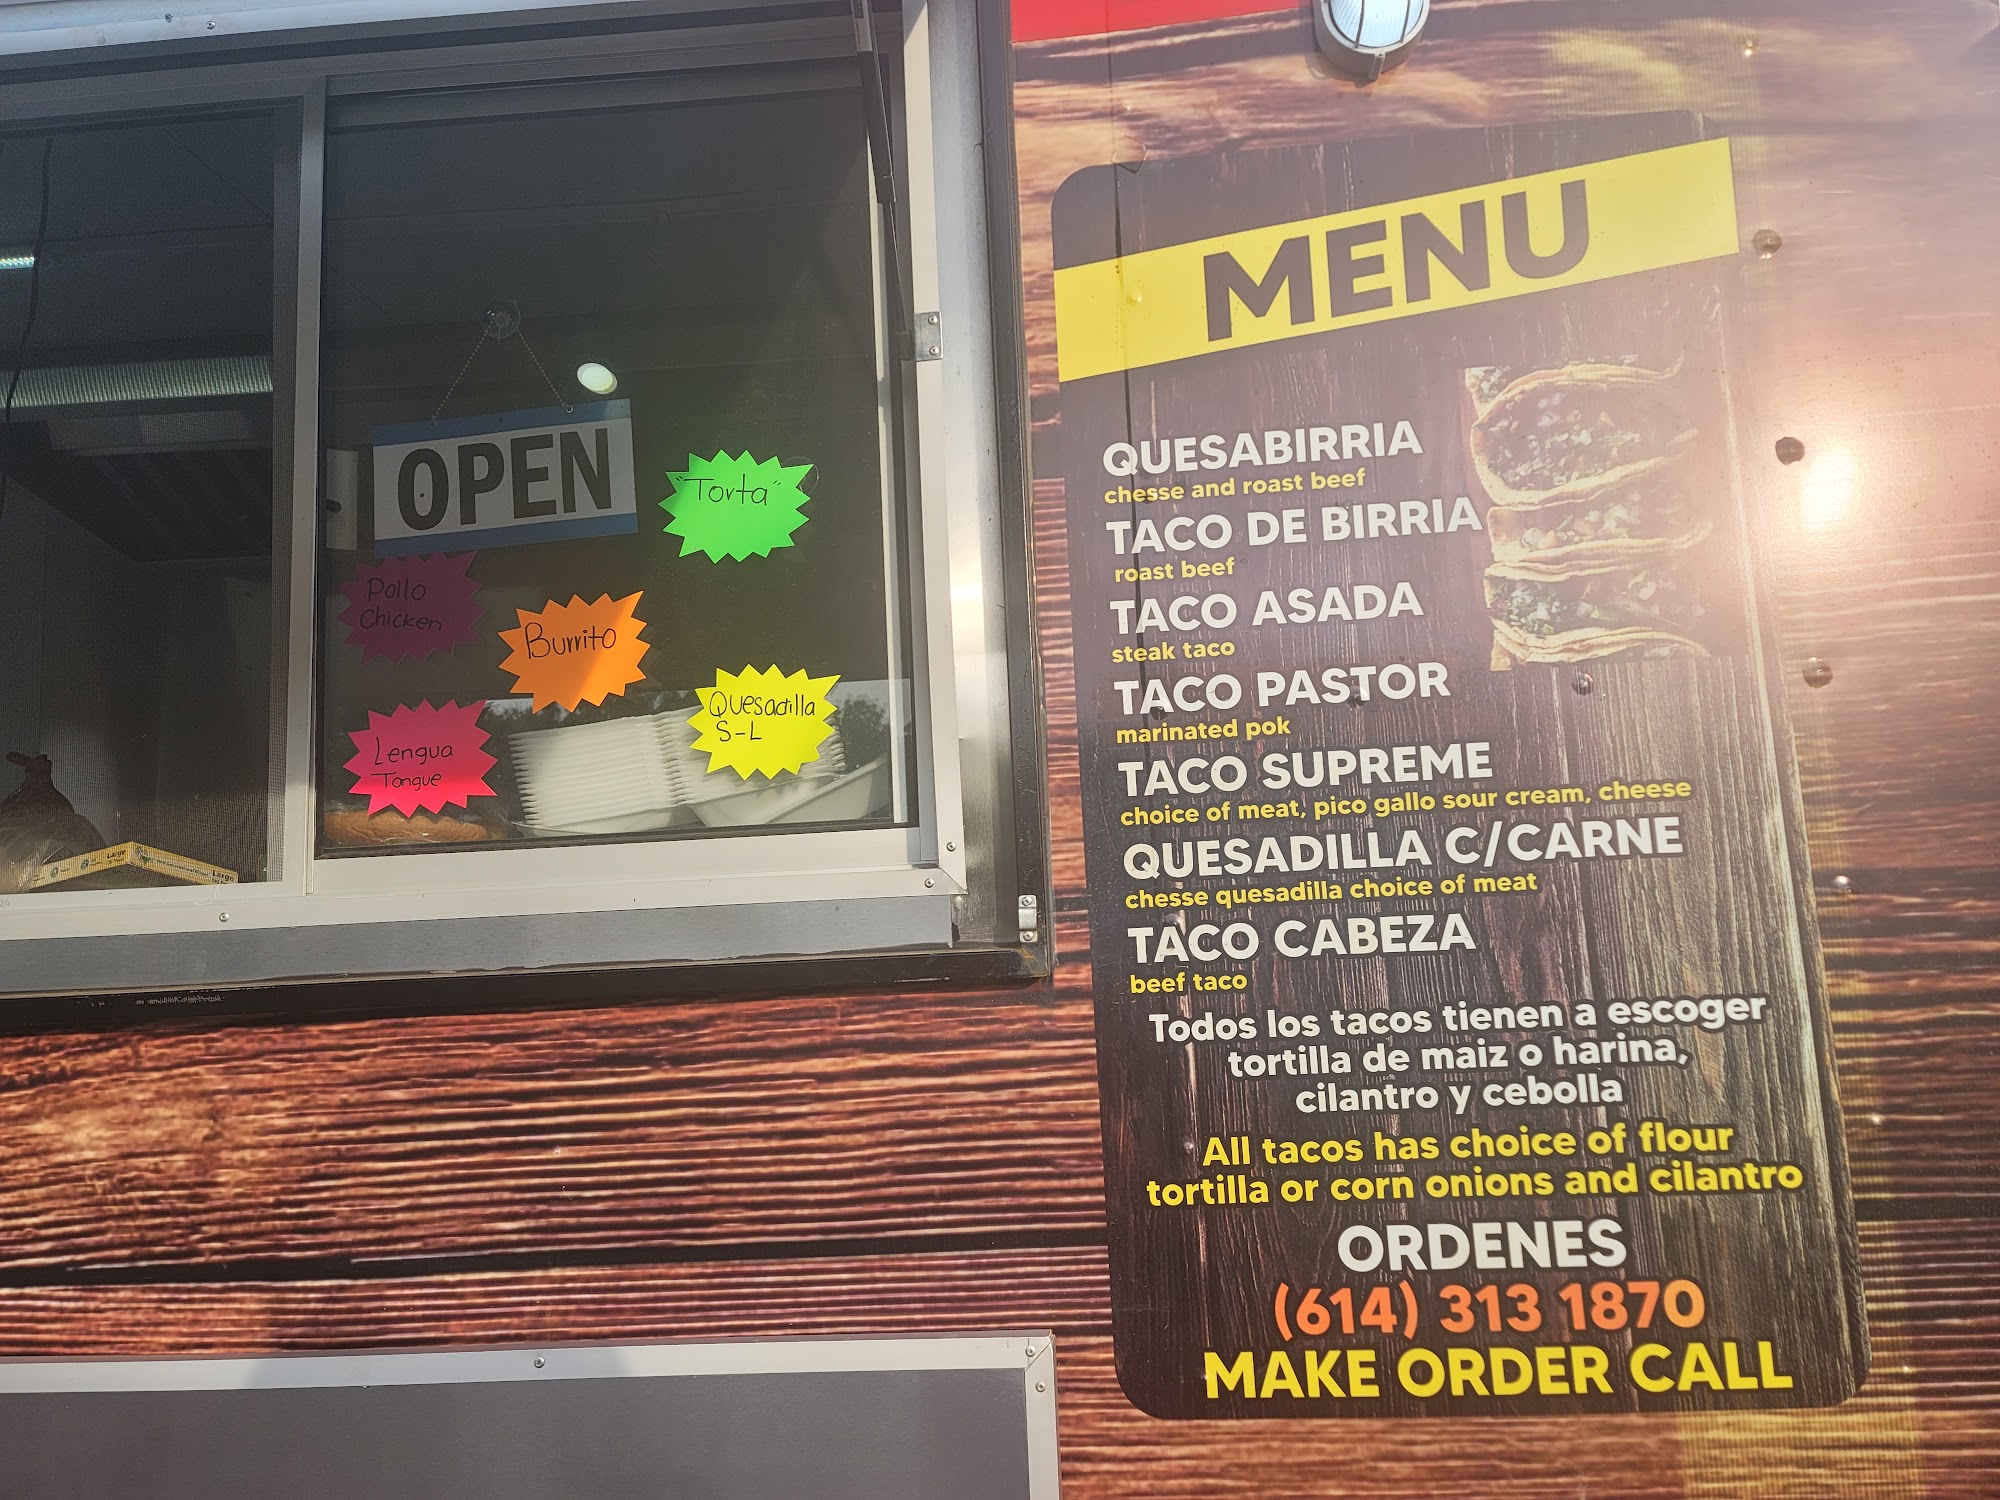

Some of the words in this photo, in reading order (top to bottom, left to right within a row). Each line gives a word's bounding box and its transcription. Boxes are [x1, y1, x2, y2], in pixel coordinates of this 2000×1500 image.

[1206, 179, 1590, 342] MENU
[1103, 420, 1423, 476] QUESABIRRIA
[398, 428, 611, 530] OPEN
[1104, 482, 1184, 504] chesse
[1191, 477, 1235, 498] and
[1242, 474, 1303, 495] roast
[1311, 468, 1365, 490] beef
[1106, 514, 1232, 555] TACO
[1248, 509, 1307, 546] DE
[1322, 497, 1483, 541] BIRRIA
[367, 578, 427, 603] Pollo
[1114, 561, 1173, 582] roast
[1181, 557, 1235, 579] beef
[360, 607, 442, 632] Chicken
[1110, 593, 1237, 634] TACO
[1252, 582, 1423, 626] ASADA
[525, 622, 617, 660] Burrito
[1112, 641, 1175, 663] steak
[1183, 640, 1235, 659] taco
[709, 692, 816, 718] Quesadilla
[1114, 673, 1242, 715] TACO
[1258, 662, 1451, 707] PASTOR
[375, 737, 454, 766] Lengua
[719, 721, 762, 742] S-L
[1116, 720, 1238, 744] marinated
[1246, 716, 1290, 739] pok
[1118, 755, 1247, 796] TACO
[1262, 742, 1493, 792] SUPREME
[1120, 803, 1199, 827] choice
[1206, 802, 1230, 823] of
[1238, 799, 1306, 821] meat,
[1314, 795, 1367, 818] pico
[1374, 791, 1435, 817] gallo
[1442, 788, 1499, 810] sour
[1504, 783, 1593, 808] cream,
[1598, 779, 1691, 802] cheese
[1123, 829, 1431, 881] QUESADILLA
[1445, 816, 1684, 868] C/CARNE
[1125, 888, 1209, 910] chesse
[1215, 880, 1344, 909] quesadilla
[1350, 876, 1433, 899] choice
[1439, 874, 1466, 895] of
[1473, 871, 1537, 894] meat
[1128, 921, 1259, 964] TACO
[1274, 913, 1475, 957] CABEZA
[1130, 972, 1186, 995] beef
[1193, 970, 1247, 991] taco
[1149, 1012, 1257, 1043] Todos
[1268, 1009, 1321, 1039] los
[1331, 1006, 1433, 1036] tacos
[1442, 1001, 1564, 1033] tienen
[1575, 1002, 1598, 1028] a
[1607, 996, 1765, 1029] escoger
[1228, 1043, 1351, 1077] tortilla
[1362, 1042, 1410, 1073] de
[1421, 1039, 1509, 1071] maiz
[1518, 1041, 1542, 1066] o
[1553, 1034, 1688, 1067] harina,
[1295, 1082, 1438, 1114] cilantro
[1449, 1083, 1472, 1115] y
[1483, 1074, 1623, 1106] cebolla
[1203, 1135, 1251, 1166] All
[1262, 1134, 1364, 1163] tacos
[1375, 1130, 1439, 1160] has
[1450, 1126, 1576, 1159] choice
[1587, 1125, 1627, 1153] of
[1637, 1122, 1733, 1151] flour
[1146, 1175, 1269, 1206] tortilla
[1279, 1175, 1320, 1201] or
[1330, 1173, 1415, 1200] corn
[1426, 1166, 1554, 1197] onions
[1565, 1162, 1638, 1192] and
[1650, 1159, 1804, 1192] cilantro
[1337, 1217, 1628, 1273] ORDENES
[1274, 1279, 1418, 1341] (614)
[1439, 1282, 1542, 1334] 313
[1559, 1279, 1705, 1332] 1870
[1204, 1348, 1380, 1398] MAKE
[1396, 1344, 1610, 1397] ORDER
[1629, 1340, 1793, 1390] CALL
